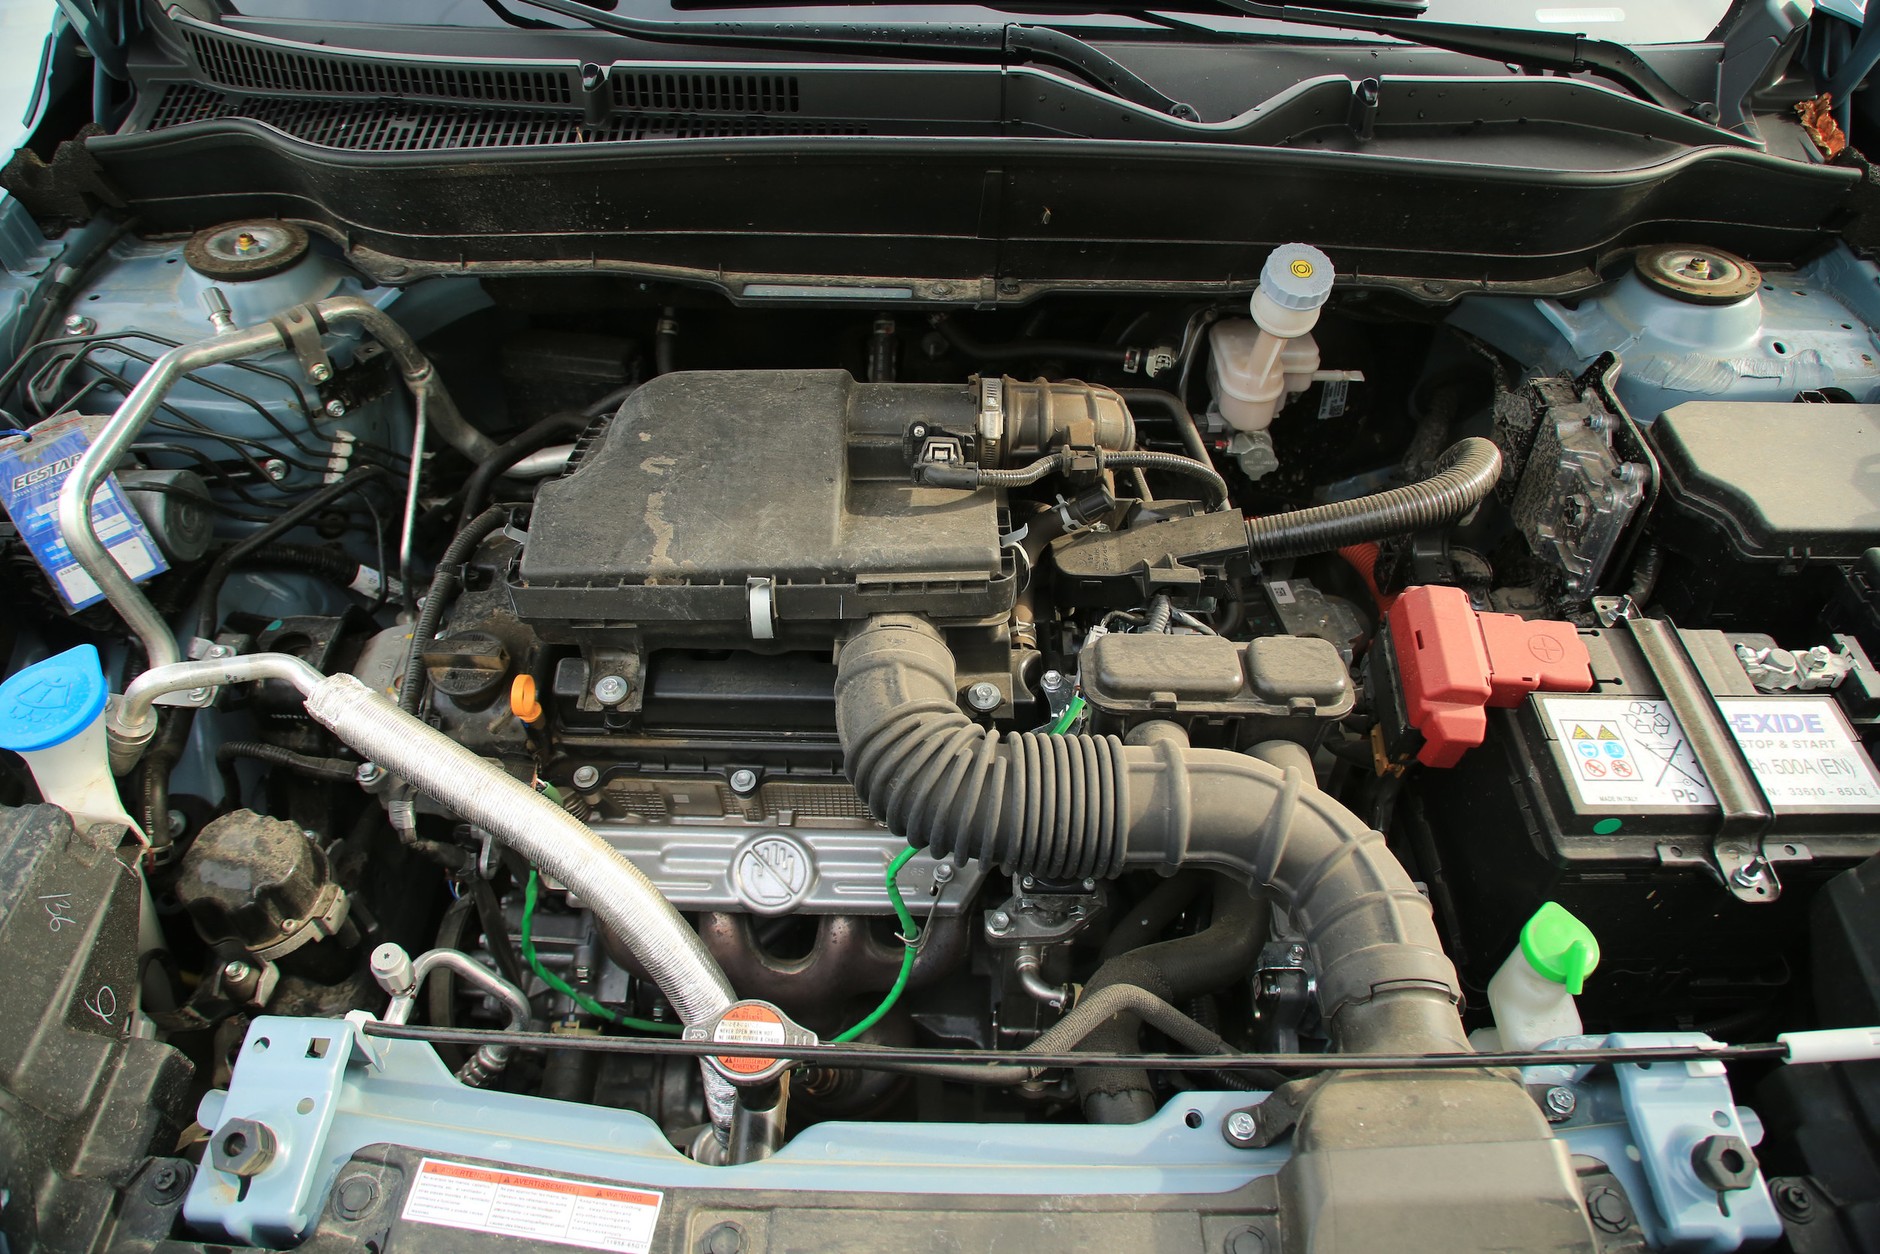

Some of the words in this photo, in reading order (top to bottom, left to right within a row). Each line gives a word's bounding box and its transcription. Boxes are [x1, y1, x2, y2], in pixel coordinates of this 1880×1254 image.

[1731, 713, 1825, 733] EXIDE
[1740, 739, 1774, 749] STOP
[1779, 739, 1788, 749] &
[1794, 739, 1837, 749] START
[1672, 788, 1700, 803] Pb
[440, 1167, 492, 1180] ADVERTENCIA
[514, 1177, 576, 1192] AVERTISSEMENT
[606, 1190, 643, 1202] WARNING
